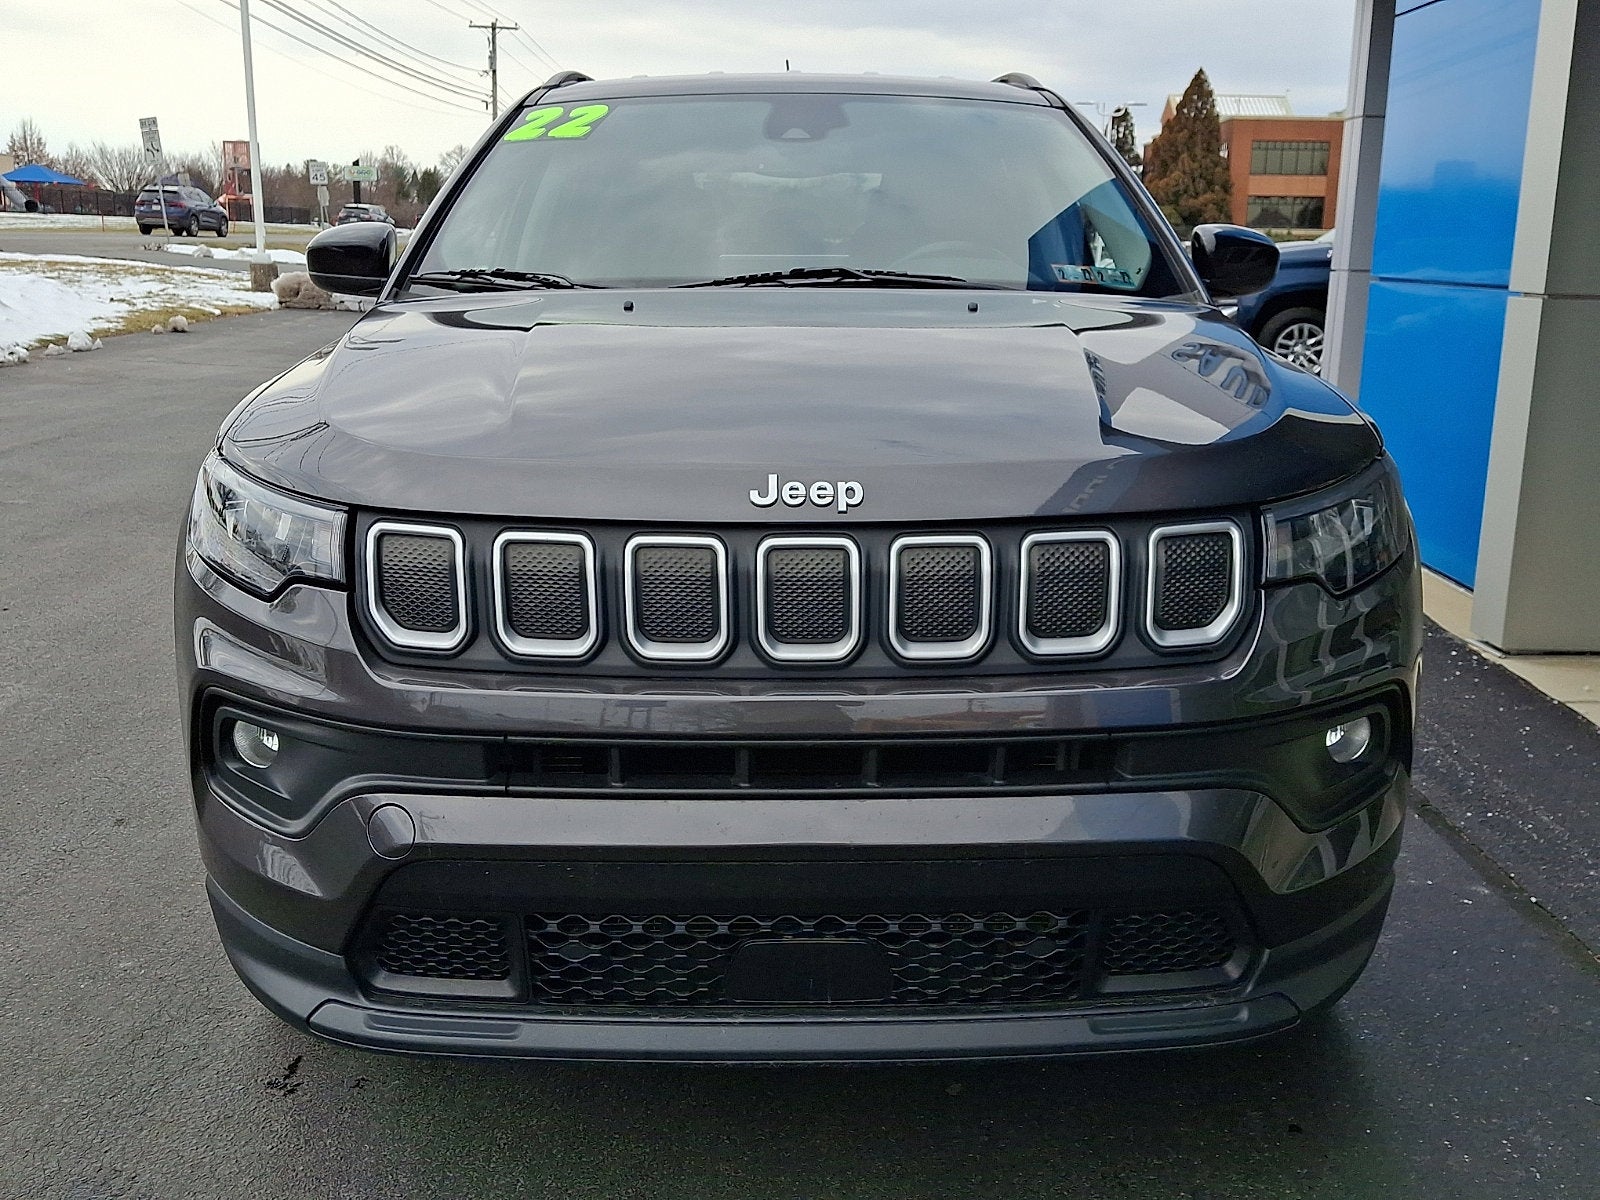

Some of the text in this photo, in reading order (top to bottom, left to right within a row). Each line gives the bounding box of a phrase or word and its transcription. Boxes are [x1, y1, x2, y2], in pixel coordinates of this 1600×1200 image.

[503, 104, 609, 142] 22
[312, 173, 326, 181] 45
[749, 473, 864, 513] Jeep
